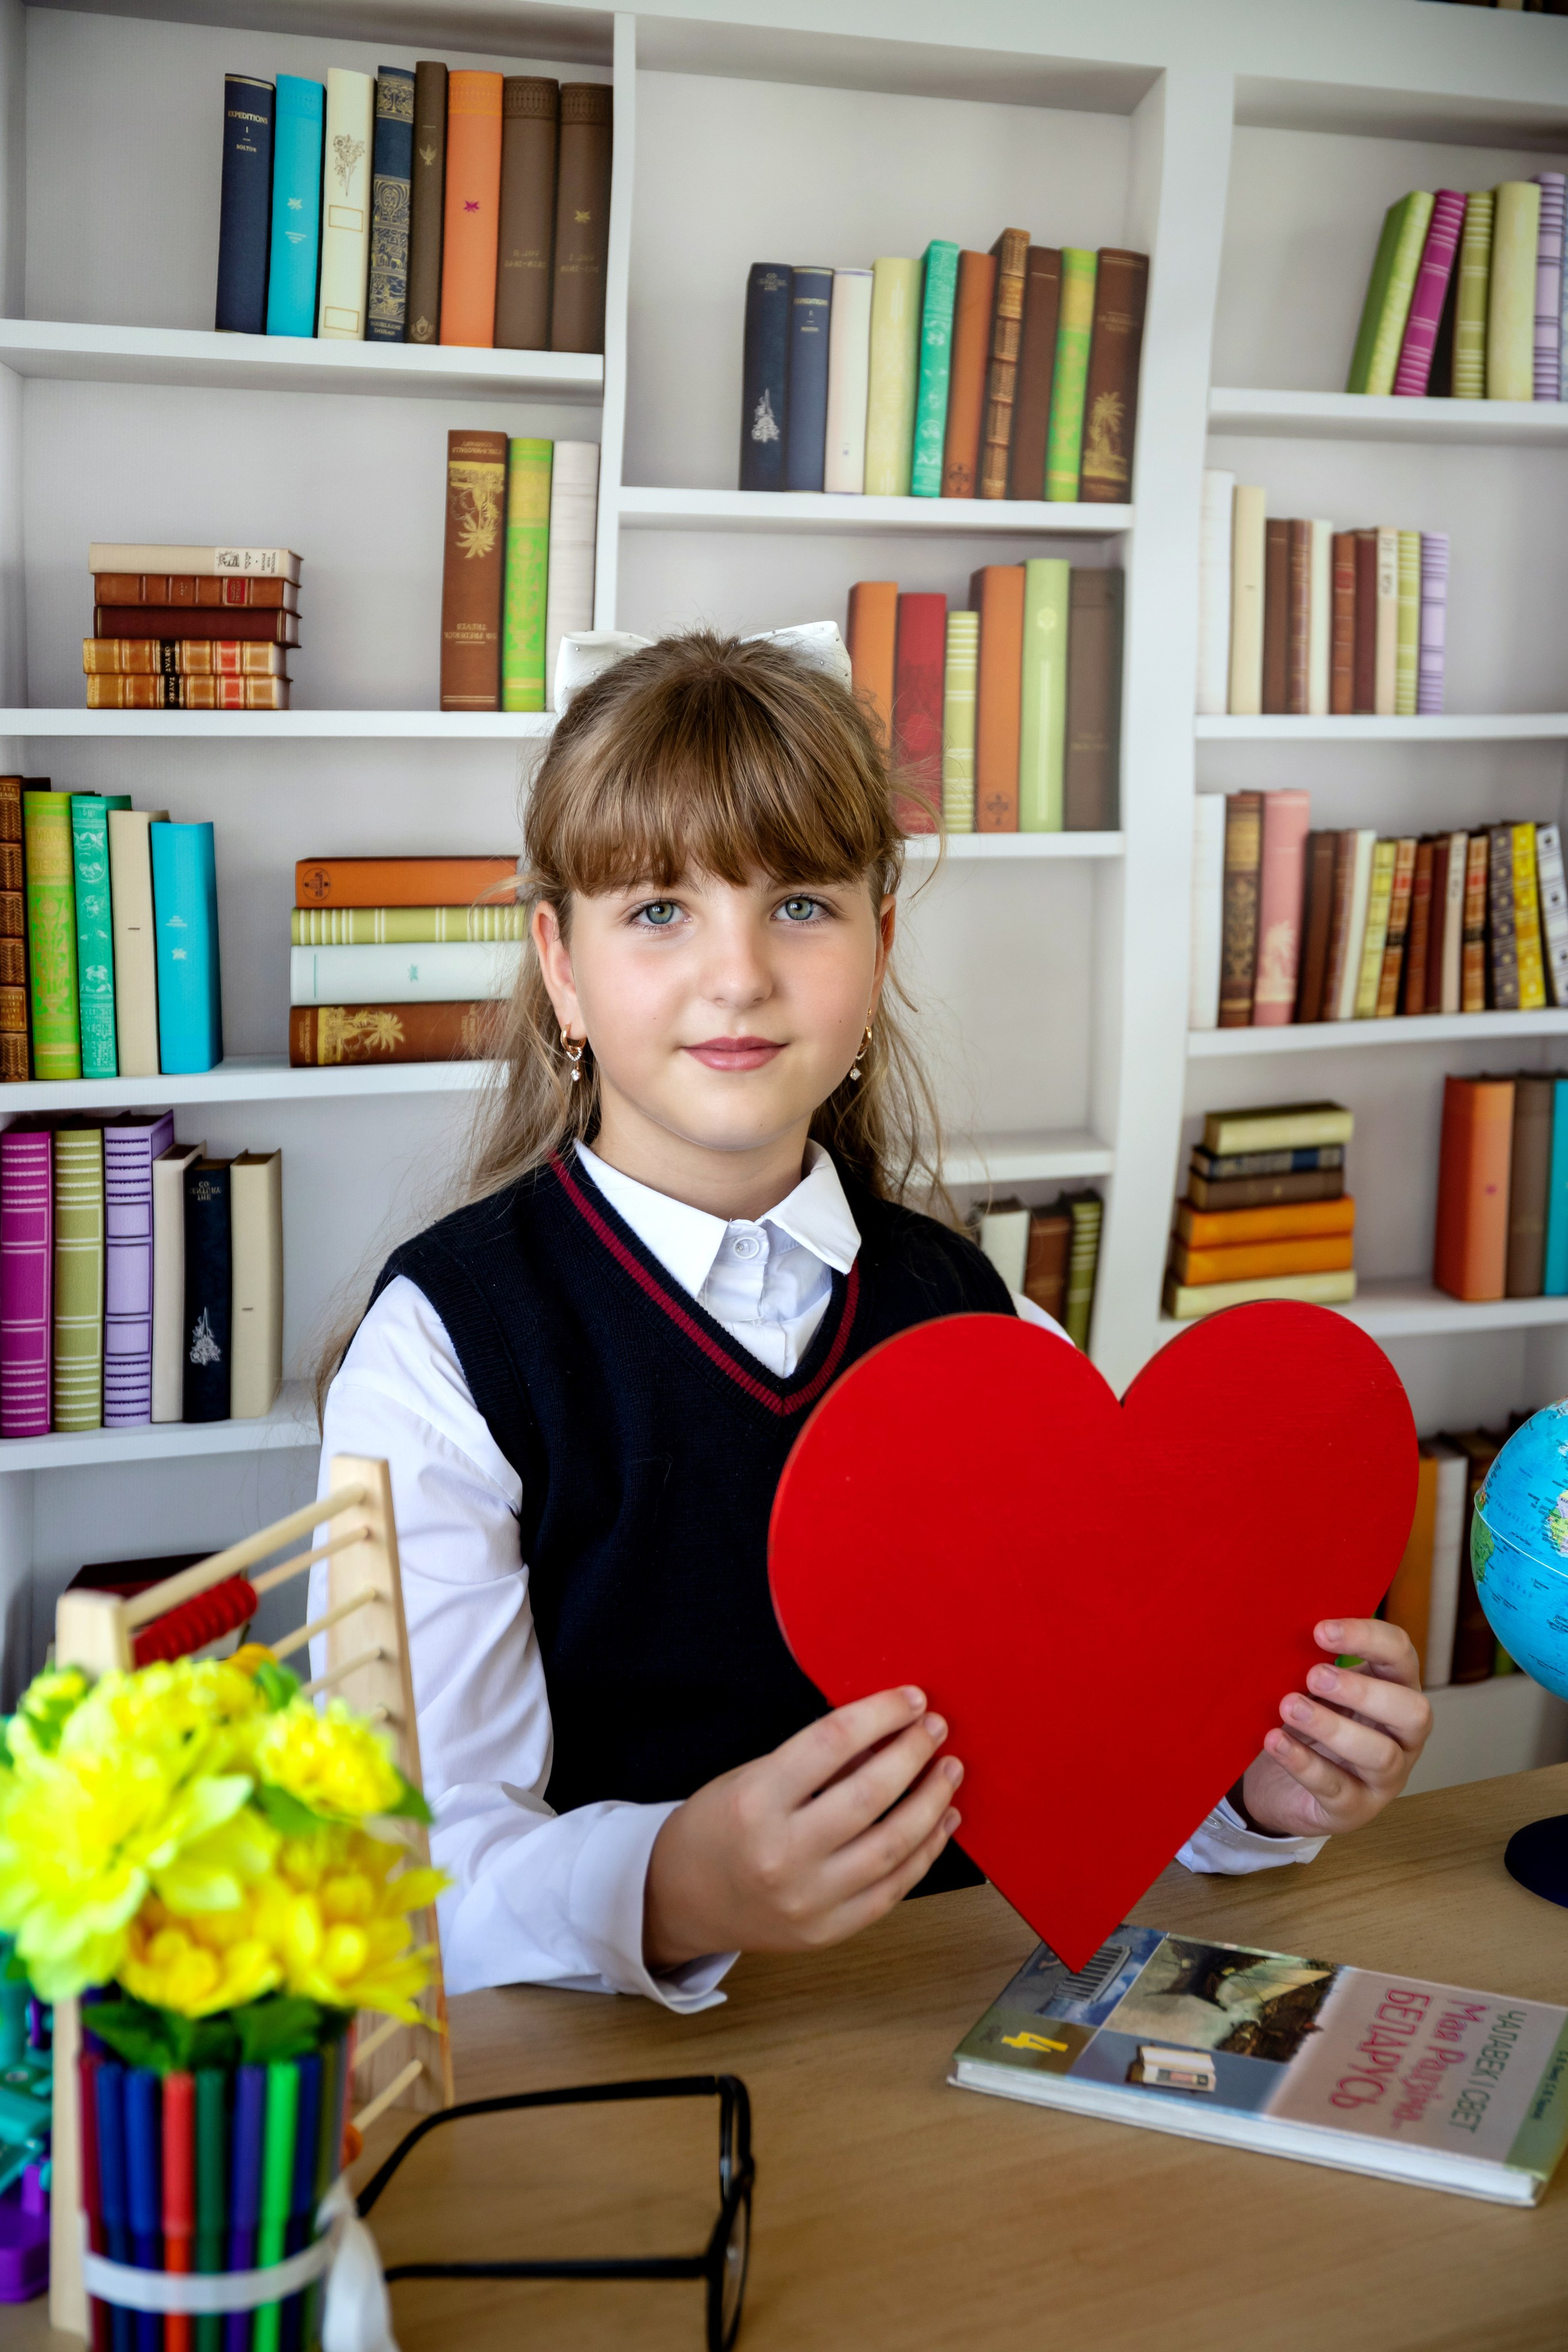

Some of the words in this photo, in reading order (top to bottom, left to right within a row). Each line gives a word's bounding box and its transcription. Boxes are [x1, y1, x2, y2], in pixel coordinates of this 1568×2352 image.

[227, 110, 268, 124] EXPEDITIONS
[1001, 2031, 1069, 2052] 4
[1432, 1999, 1490, 2042] Мая
[1329, 1988, 1434, 2109] БЕЛАРУСЬ
[1470, 2010, 1527, 2081] ЧАЛАВЕК
[1448, 2087, 1491, 2133] СВЕТ
